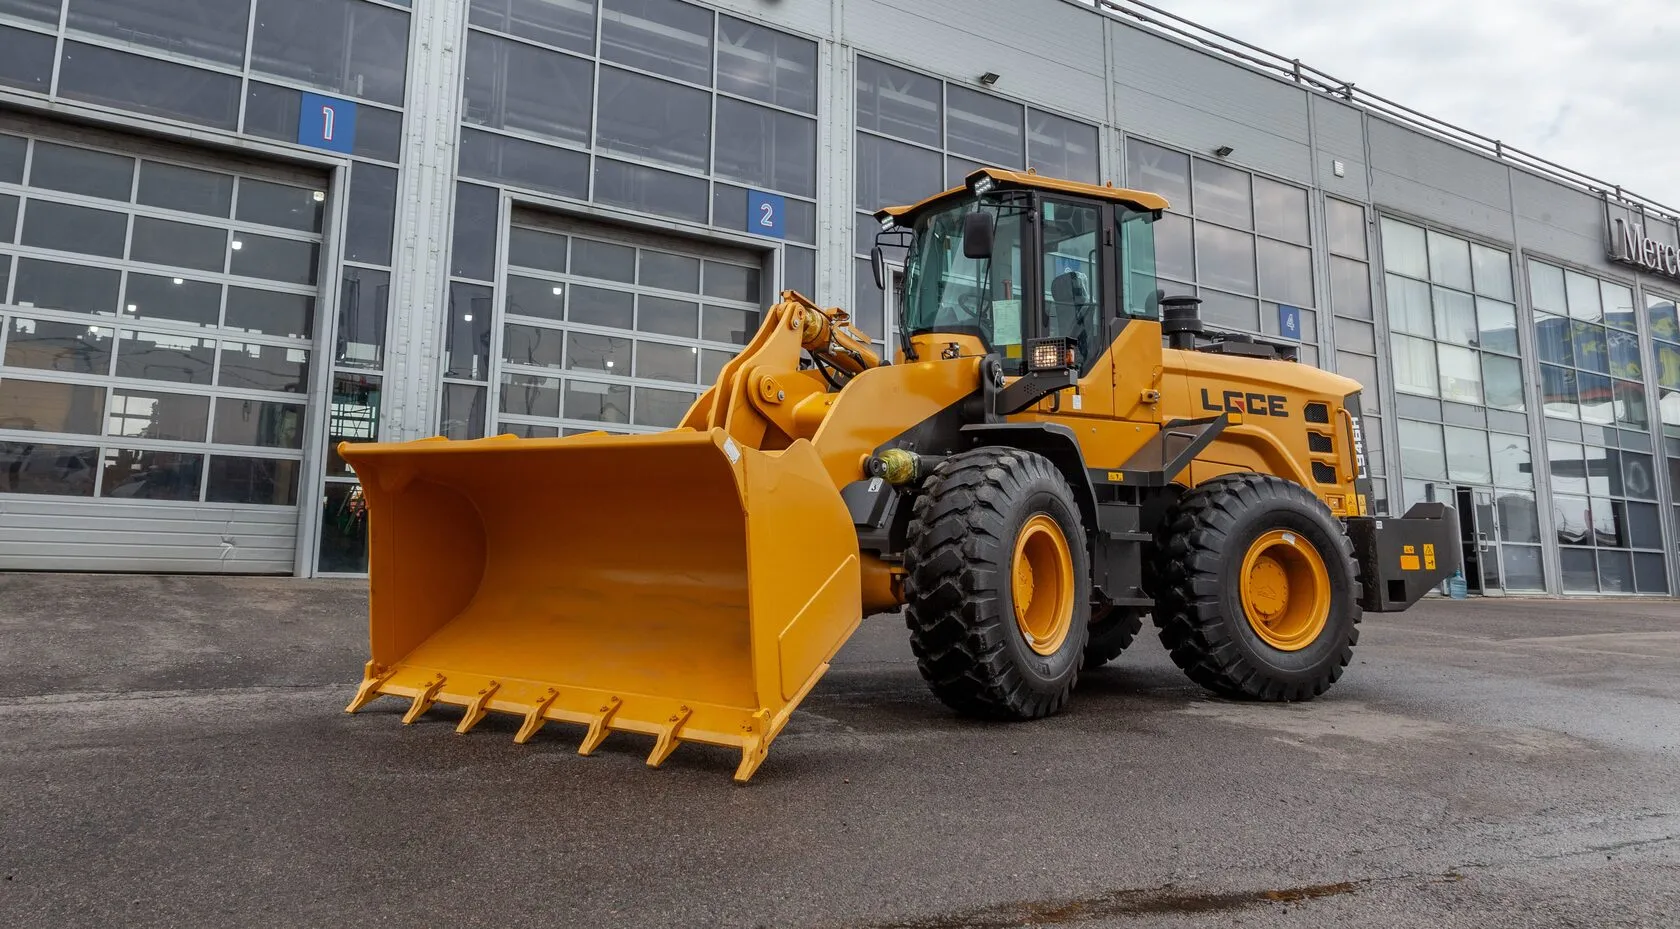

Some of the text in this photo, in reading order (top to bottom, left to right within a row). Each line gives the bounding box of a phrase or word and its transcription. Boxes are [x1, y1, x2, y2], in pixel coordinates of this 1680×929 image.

[322, 106, 335, 141] 1
[760, 203, 773, 227] 2
[1615, 217, 1680, 275] Merc
[1286, 313, 1295, 331] 4
[1200, 388, 1289, 417] LGCE
